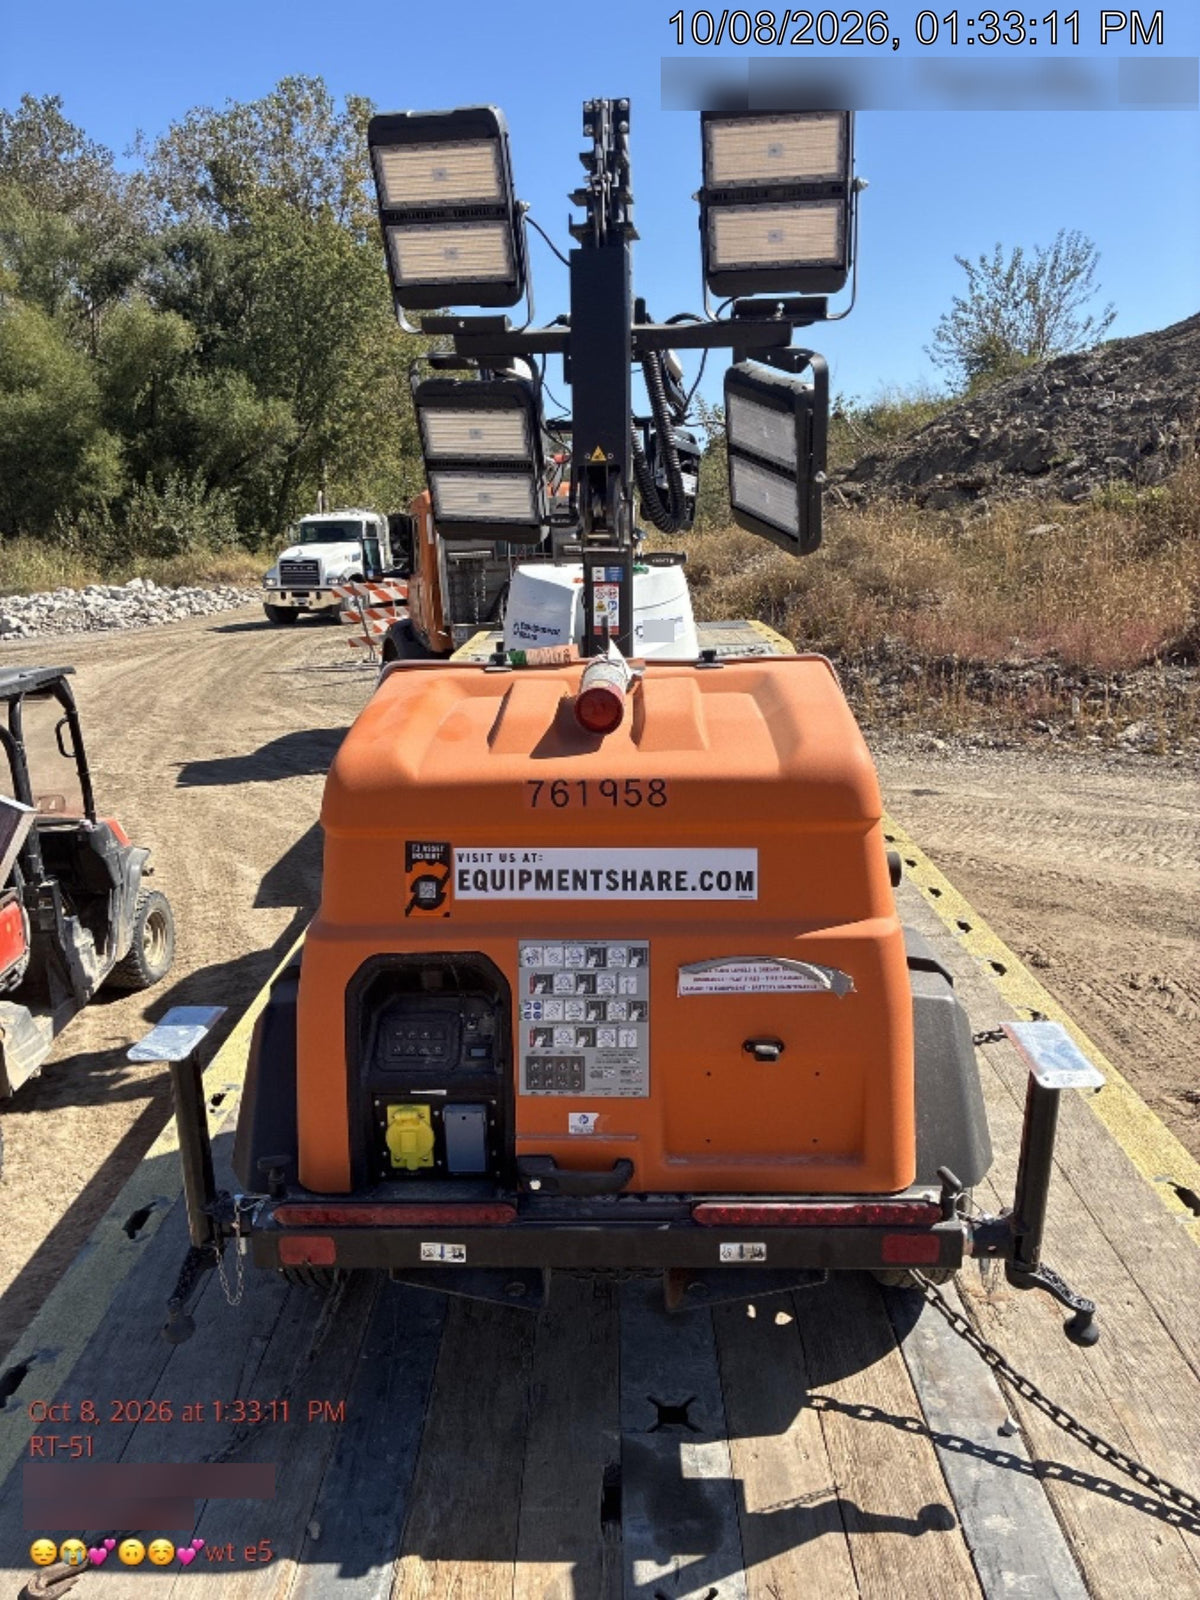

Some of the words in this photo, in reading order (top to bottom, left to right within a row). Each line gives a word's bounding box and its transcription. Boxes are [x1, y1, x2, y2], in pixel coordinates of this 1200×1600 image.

[526, 778, 668, 808] 761958
[456, 852, 493, 864] VISIT
[499, 853, 517, 864] US
[522, 853, 544, 864] AT:
[457, 869, 755, 893] EQUIPMENTSHARE.COM
